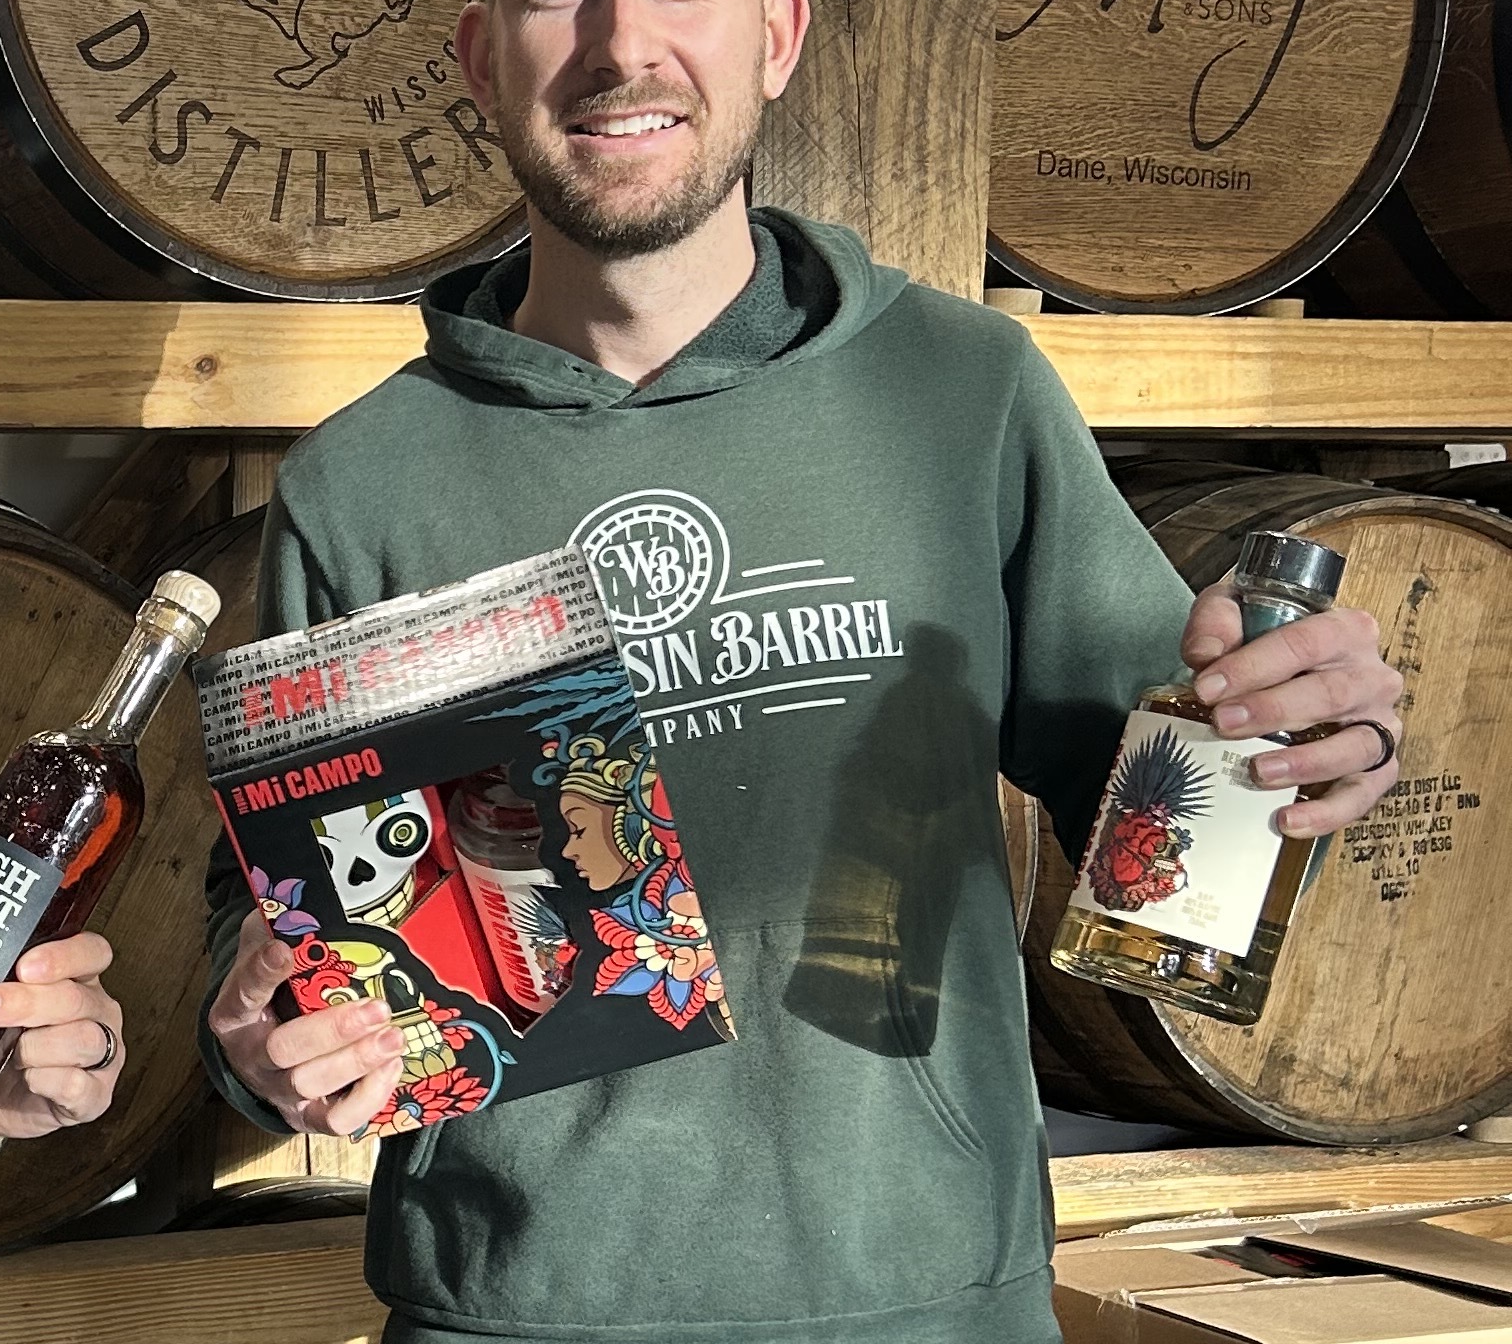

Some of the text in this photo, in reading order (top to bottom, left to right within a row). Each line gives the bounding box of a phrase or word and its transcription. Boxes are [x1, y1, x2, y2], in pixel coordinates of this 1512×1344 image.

[76, 9, 505, 227] DISTILLER
[1036, 150, 1252, 192] Dane, Wisconsin
[710, 599, 904, 685] BARREL
[643, 704, 743, 748] MPANY
[243, 775, 287, 812] Mi
[284, 747, 383, 800] CAMPO
[1414, 777, 1438, 794] DIST
[1442, 773, 1461, 791] LLC
[492, 921, 540, 1003] CAMPO
